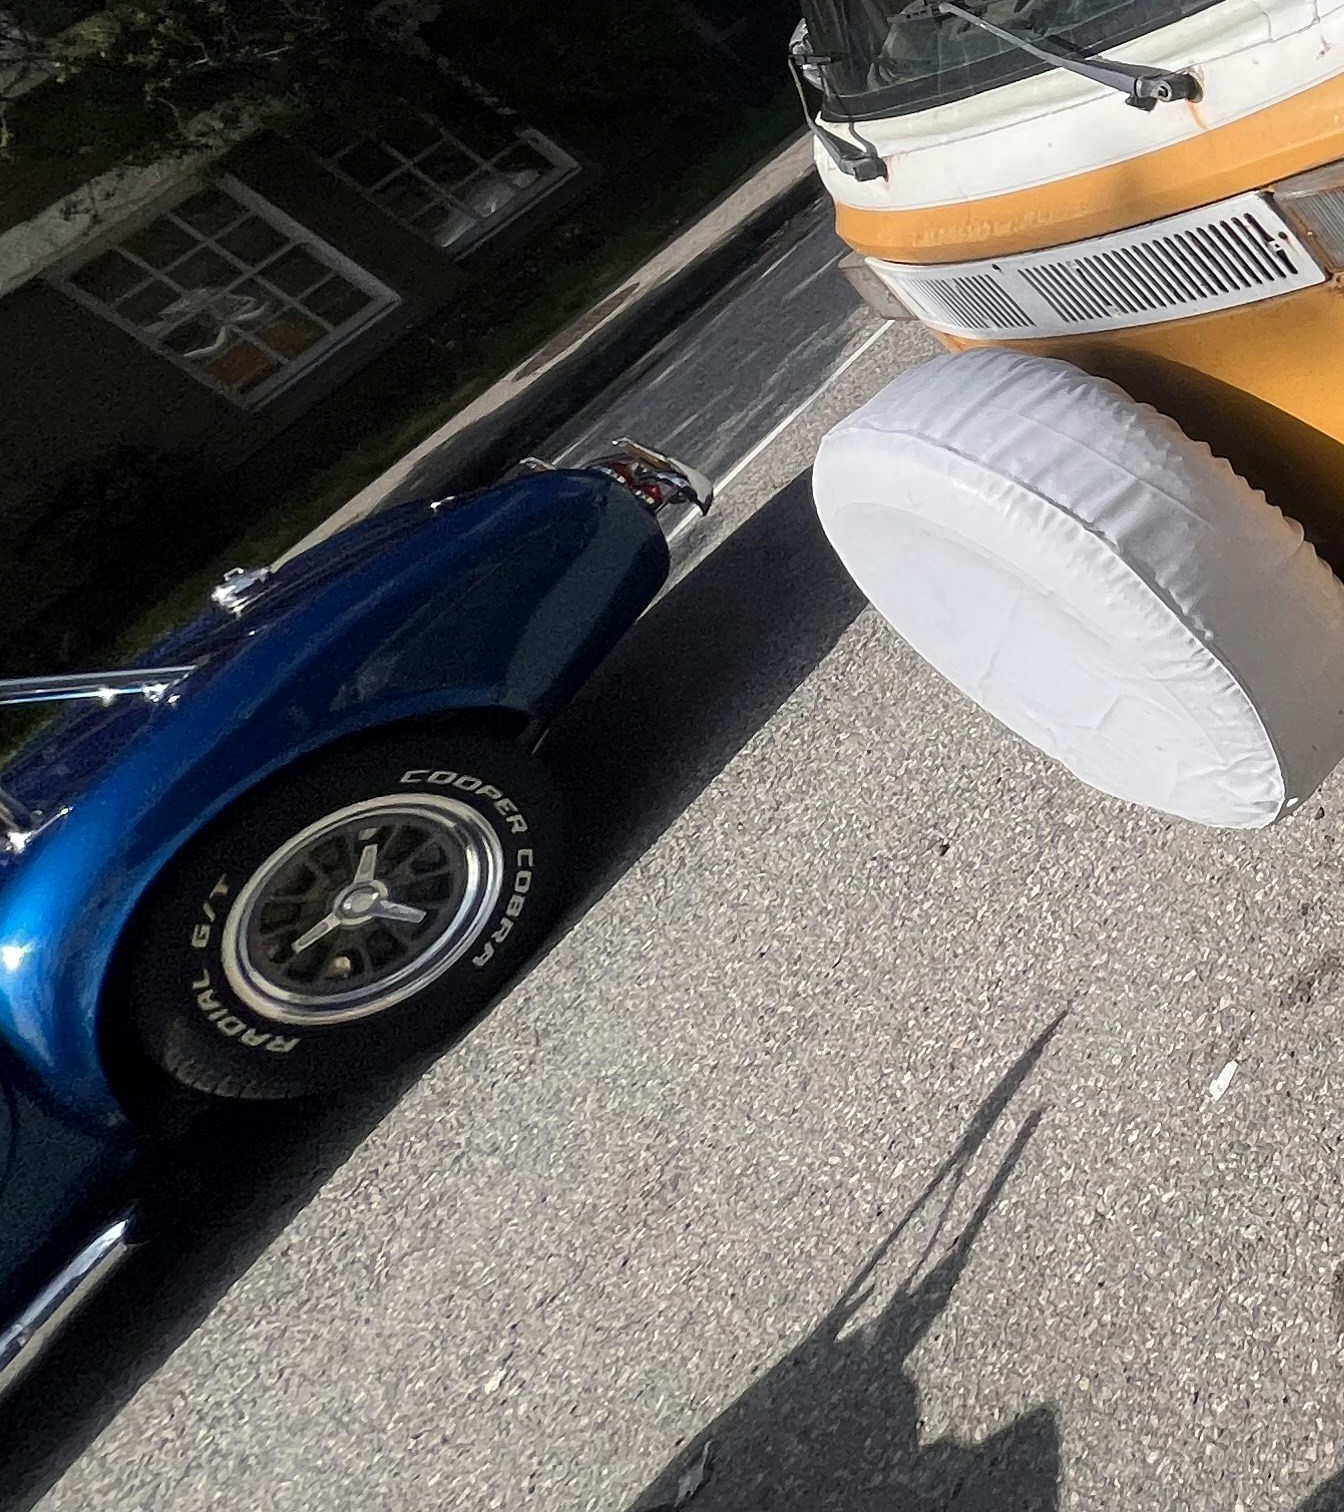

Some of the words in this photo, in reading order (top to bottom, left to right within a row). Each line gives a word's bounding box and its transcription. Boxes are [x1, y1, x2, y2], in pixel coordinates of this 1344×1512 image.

[190, 873, 232, 950] G/T
[399, 768, 530, 835] COOPER
[471, 847, 535, 969] COBRA
[190, 967, 303, 1055] RADIAL
